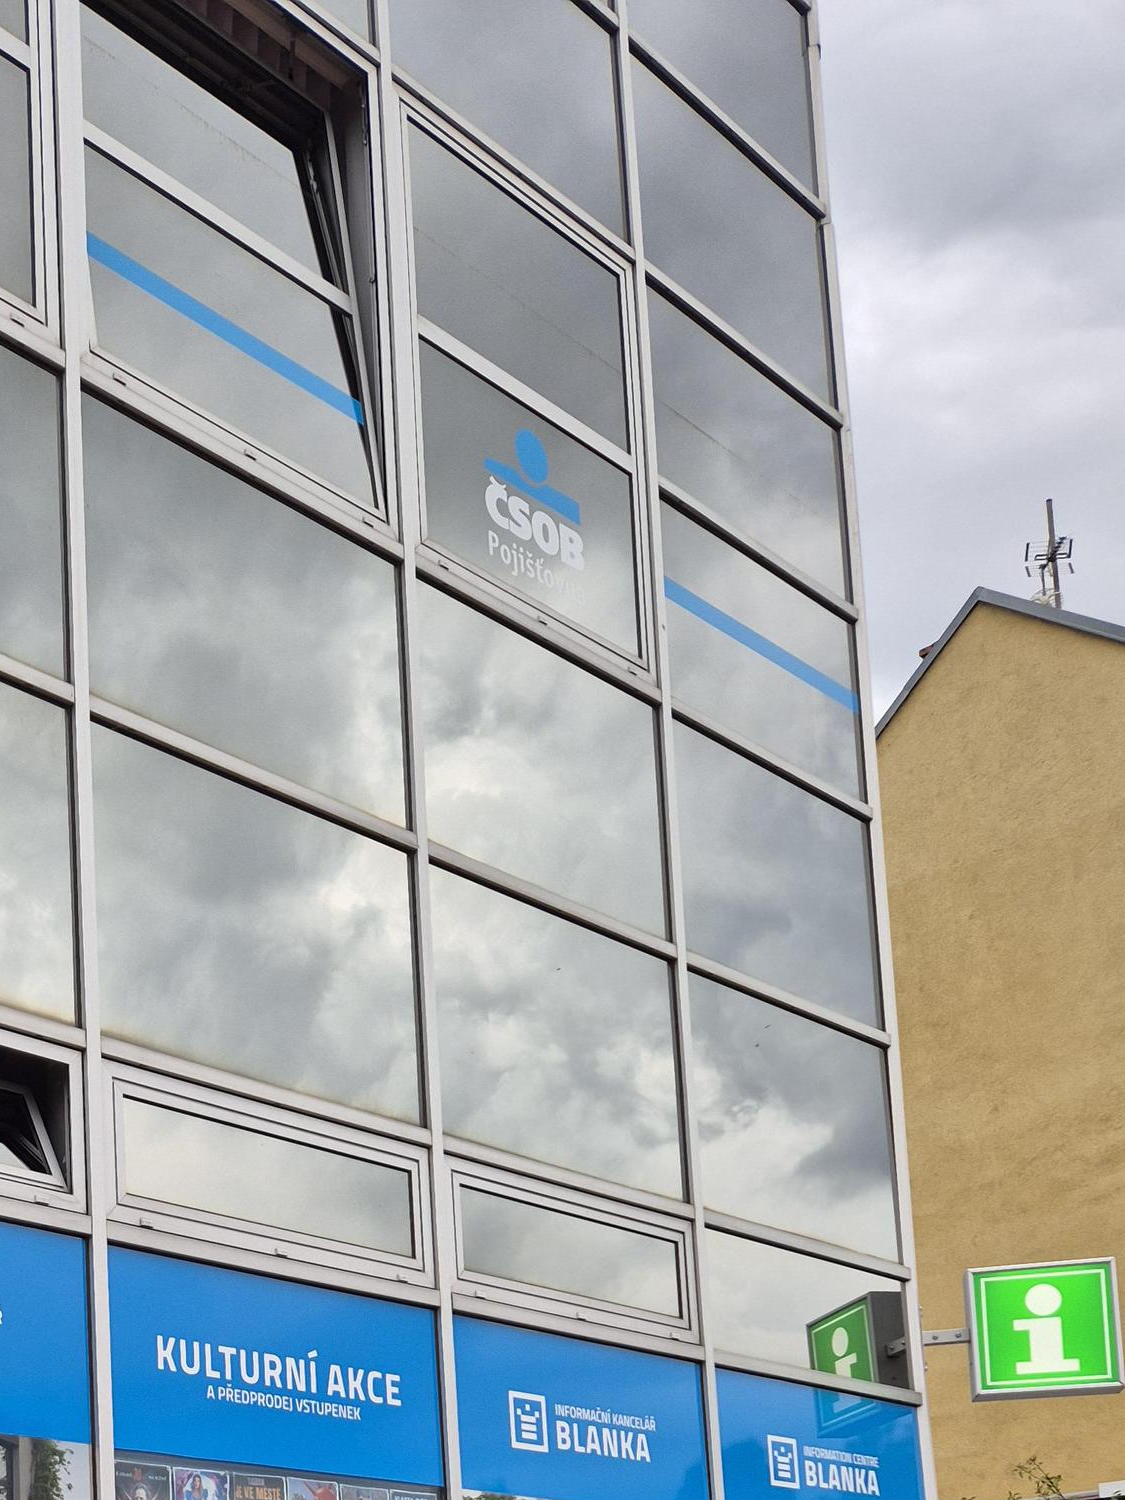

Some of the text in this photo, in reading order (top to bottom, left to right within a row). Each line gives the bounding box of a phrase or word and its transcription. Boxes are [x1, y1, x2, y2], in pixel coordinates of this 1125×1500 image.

[484, 475, 585, 571] ČSOB
[156, 1335, 403, 1407] KULTURNÍ AKCE
[206, 1382, 362, 1421] A PŘEDPRODEJ VSTUPENEK
[554, 1403, 657, 1432] INFORMAČNÍ KANCELÁŘ
[555, 1420, 652, 1463] BLANKA
[803, 1445, 880, 1468] INFORMATION CENTRE
[804, 1460, 881, 1497] BLANKA
